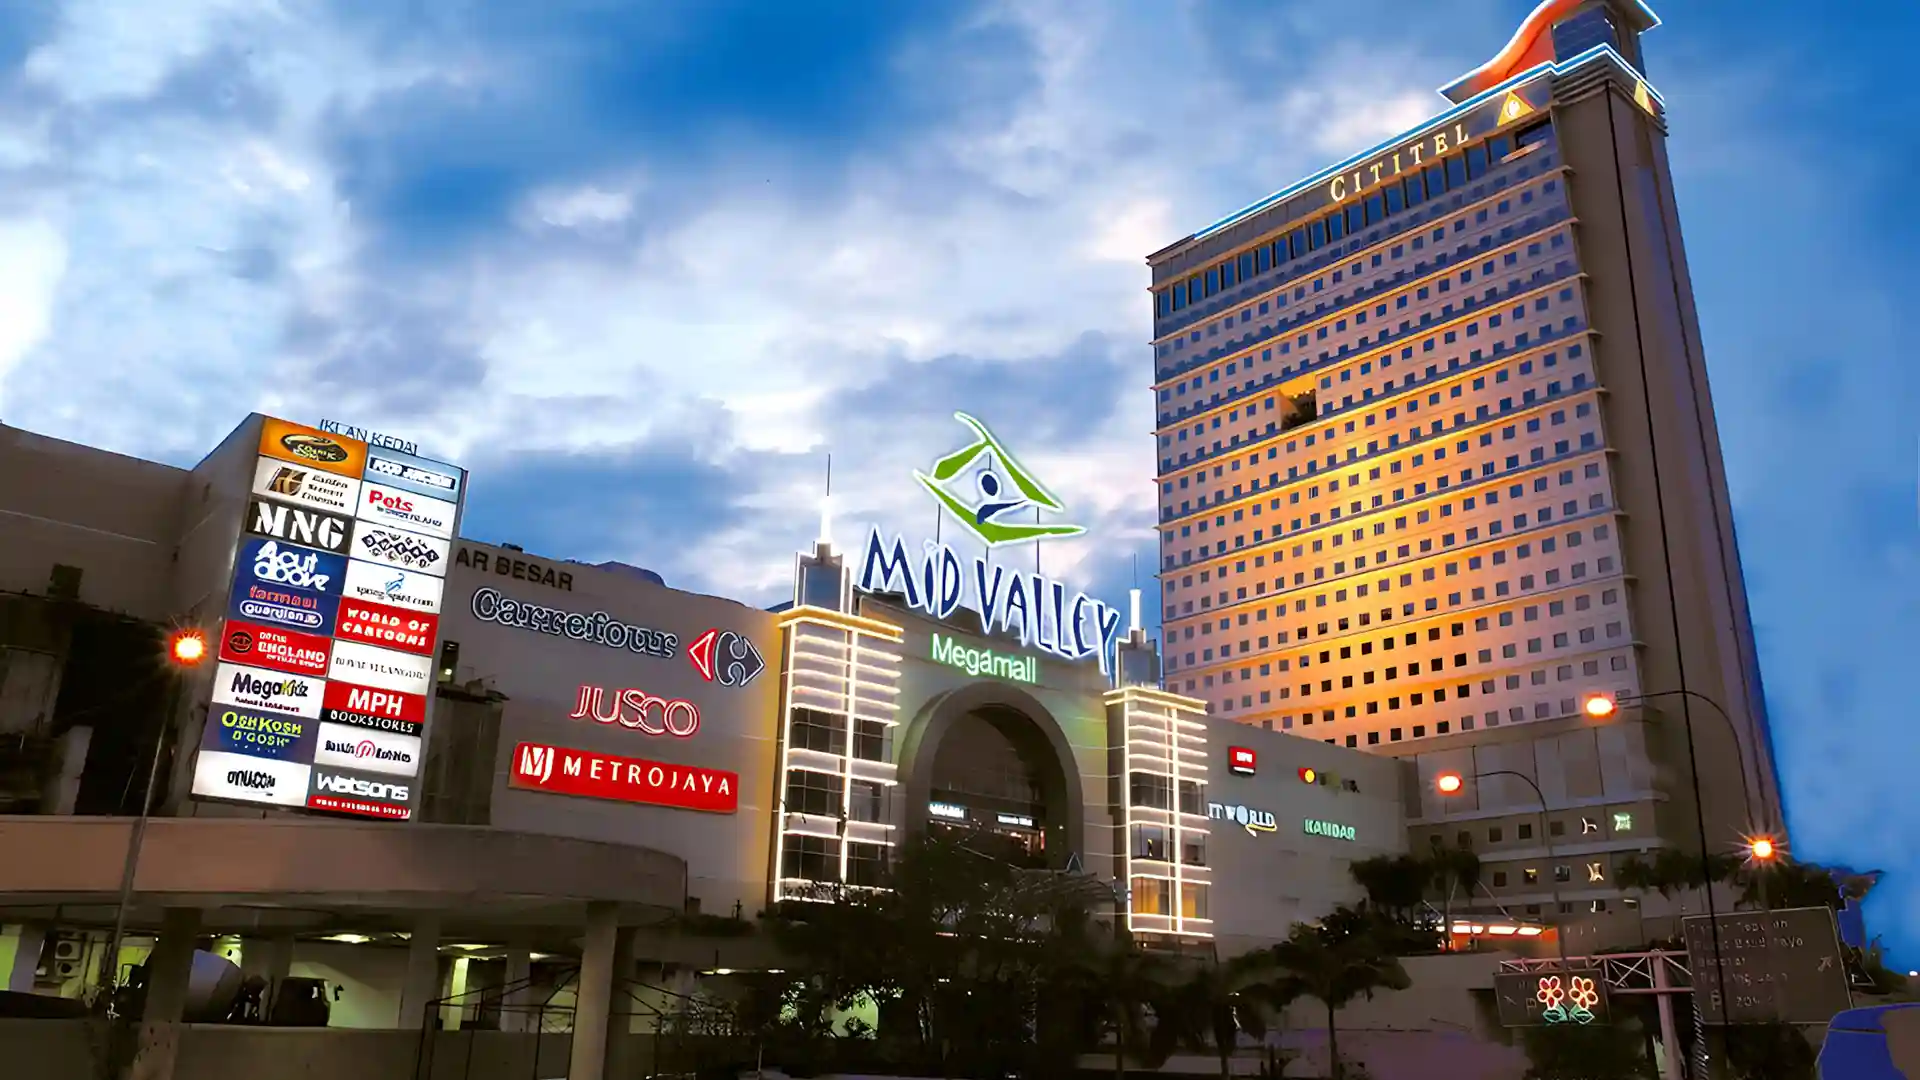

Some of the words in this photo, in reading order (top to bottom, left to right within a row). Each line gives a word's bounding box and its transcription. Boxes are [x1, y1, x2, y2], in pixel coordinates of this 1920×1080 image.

[1330, 123, 1471, 204] CITITEL
[371, 431, 418, 457] KEDAI
[253, 501, 346, 550] MNG
[495, 556, 574, 592] BESAR
[347, 607, 401, 627] WORLD
[408, 619, 430, 633] OF
[471, 586, 679, 660] Carrefour
[974, 558, 1121, 684] VALLEY
[257, 641, 326, 664] ENGLAND
[932, 632, 1037, 684] Megamall
[330, 709, 415, 734] BOOKSTORES
[347, 687, 404, 717] MPH
[570, 685, 700, 736] JUSCO
[563, 754, 731, 796] METROJAYA
